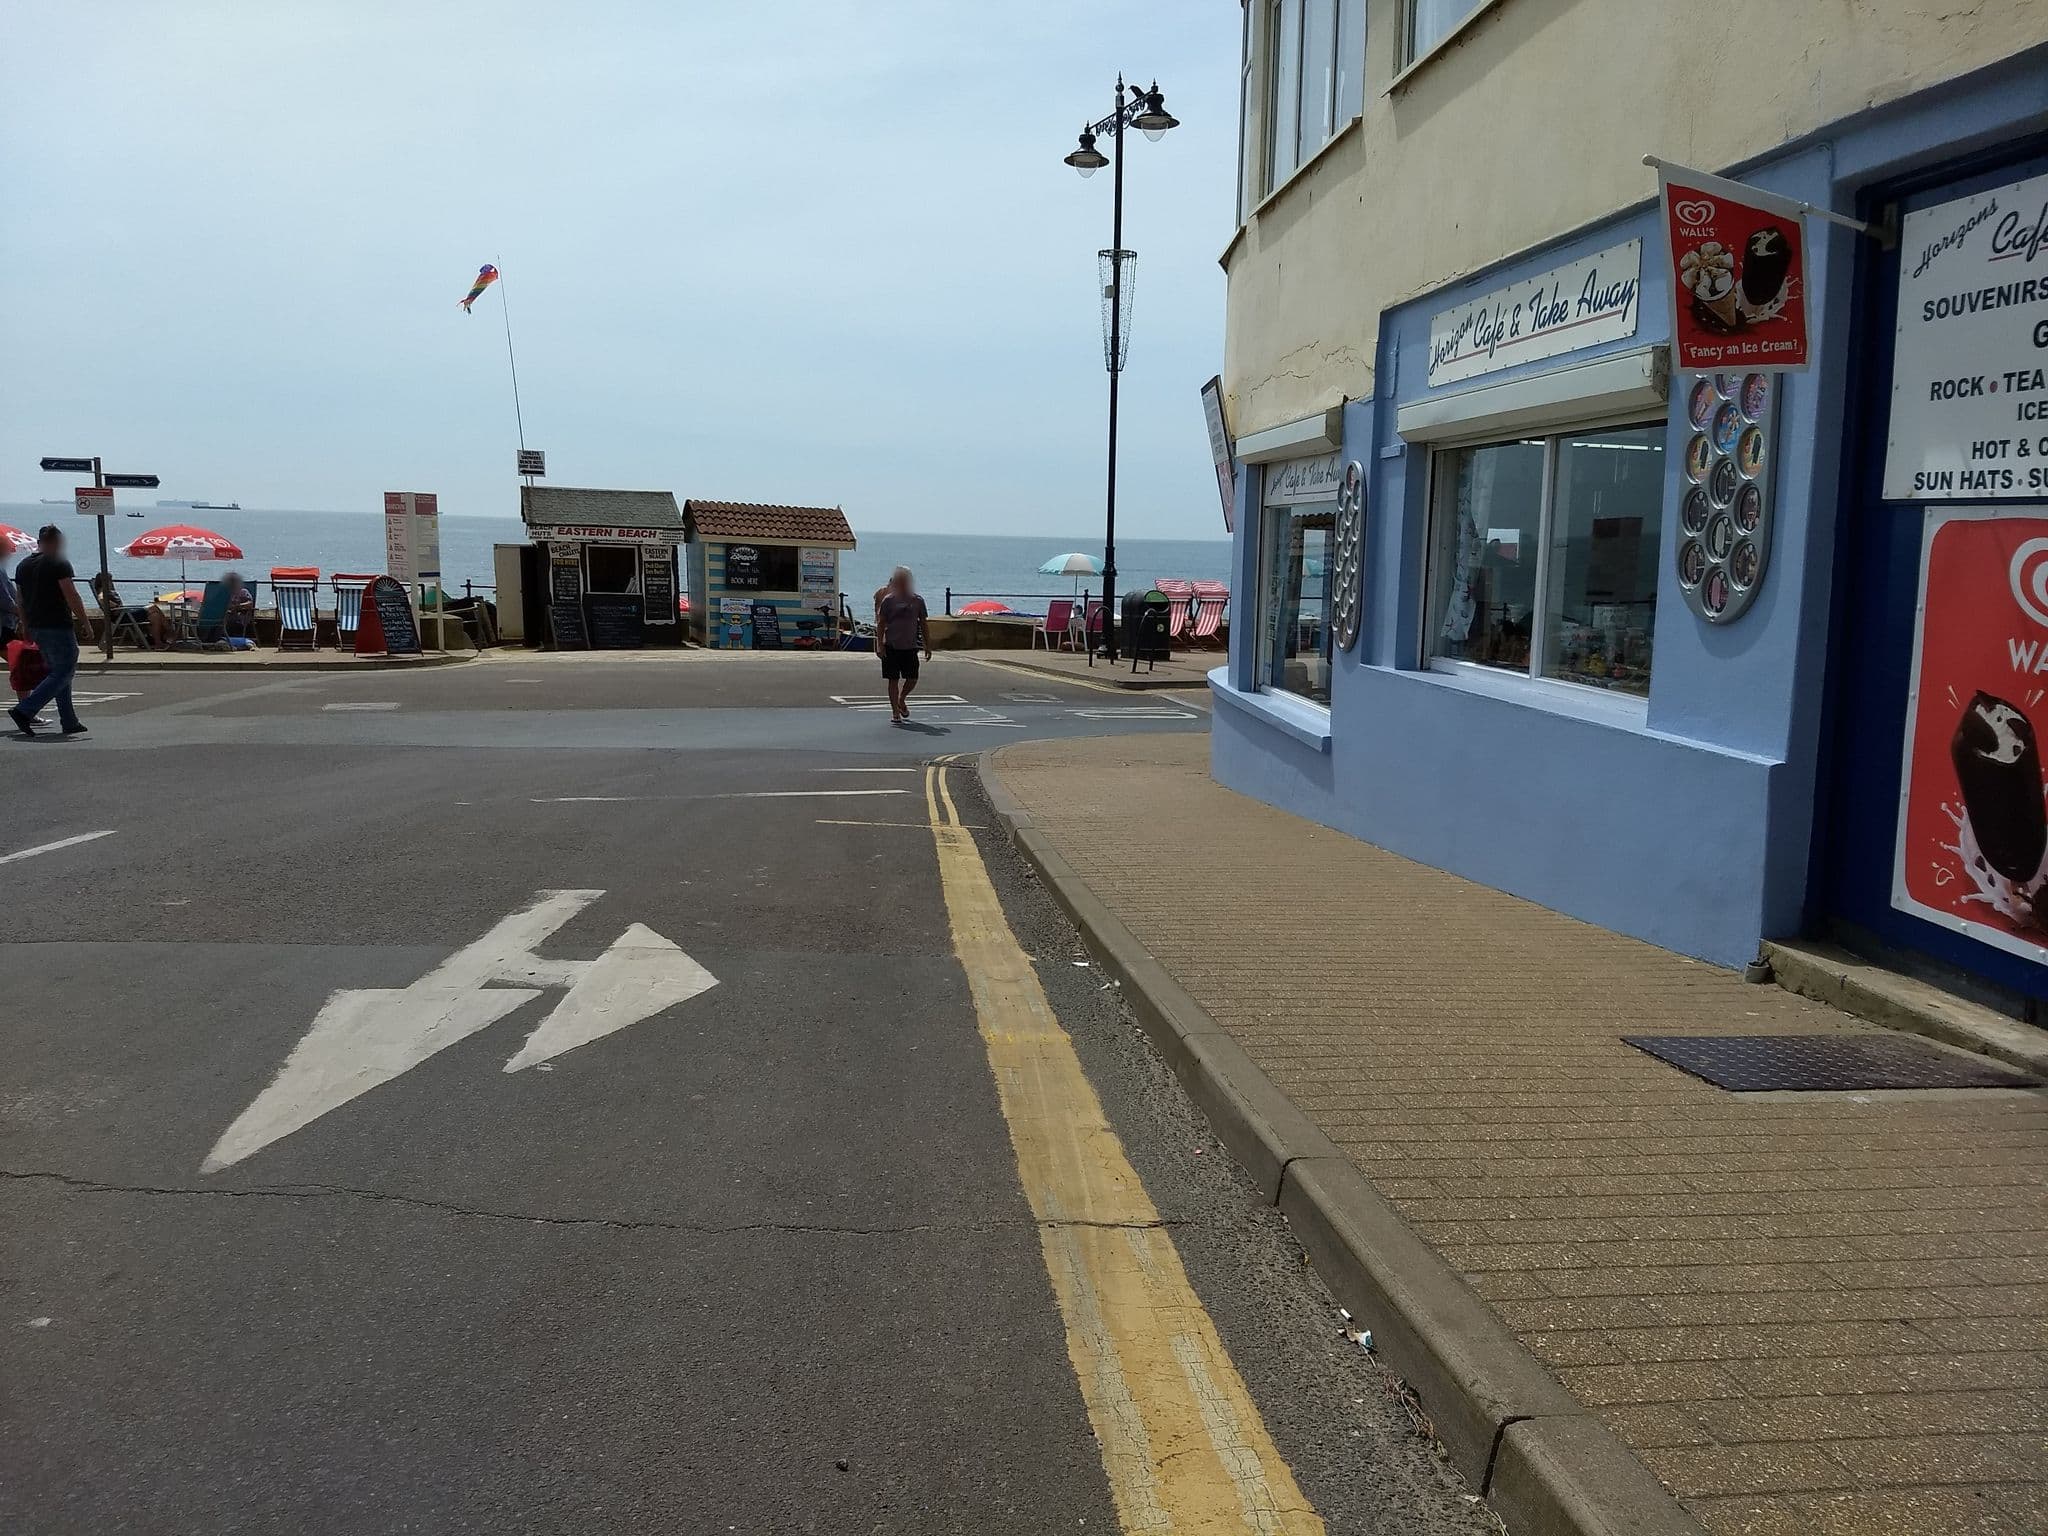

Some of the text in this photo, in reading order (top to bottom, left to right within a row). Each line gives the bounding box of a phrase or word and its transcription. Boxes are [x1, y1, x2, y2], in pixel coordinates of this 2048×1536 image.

[1680, 227, 1715, 237] WALL'S
[1913, 198, 1999, 279] Horizons
[1923, 277, 2048, 322] SOUVENIRS
[1429, 268, 1635, 377] Horizon Café & Take Away
[1690, 340, 1798, 360] Fancy an Ice Cream?
[1930, 369, 2046, 401] ROCK TEA
[2018, 400, 2048, 421] ICE
[1972, 440, 2011, 459] HOT
[2017, 438, 2031, 458] &
[1914, 472, 1953, 491] SUN
[1960, 469, 2014, 490] HATS
[557, 526, 613, 537] EASTERN
[618, 528, 657, 538] BEACH
